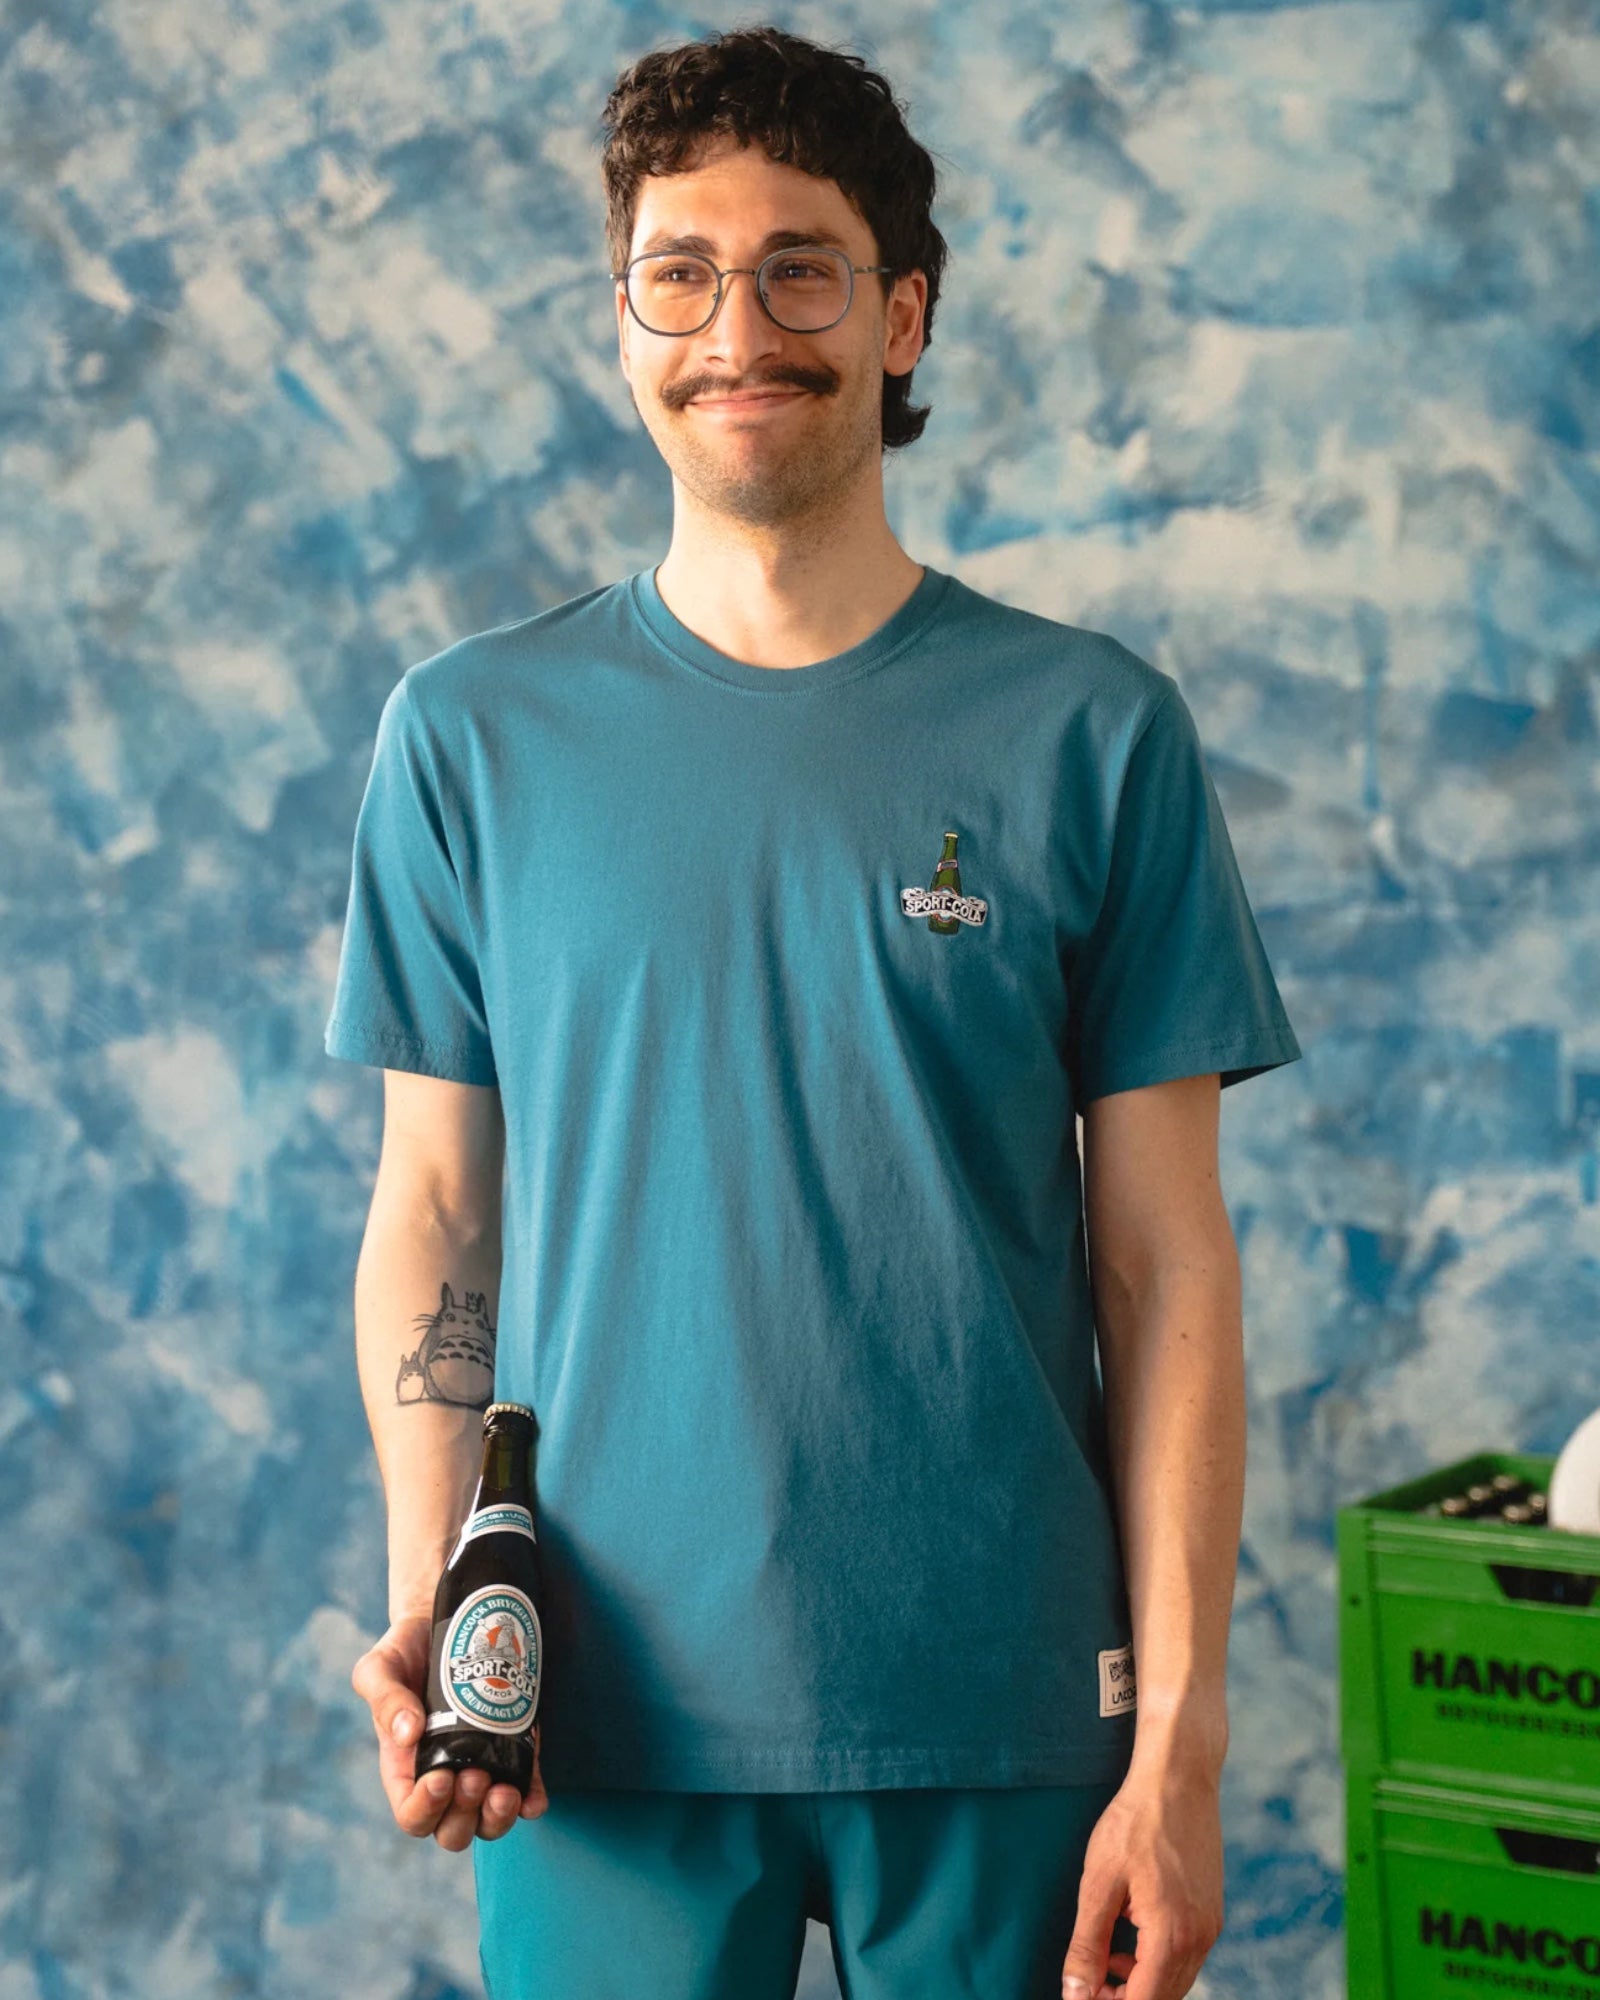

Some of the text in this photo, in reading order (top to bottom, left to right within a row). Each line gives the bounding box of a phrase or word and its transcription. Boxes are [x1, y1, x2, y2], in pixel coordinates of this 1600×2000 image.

[905, 895, 981, 922] SPORT-COLA
[454, 1604, 488, 1656] HANCOCK
[453, 1659, 533, 1698] SPORT-COLA
[1411, 1647, 1600, 1710] HANCO
[460, 1687, 511, 1718] GRUNDLAGT
[1419, 1907, 1600, 1977] HANCO
